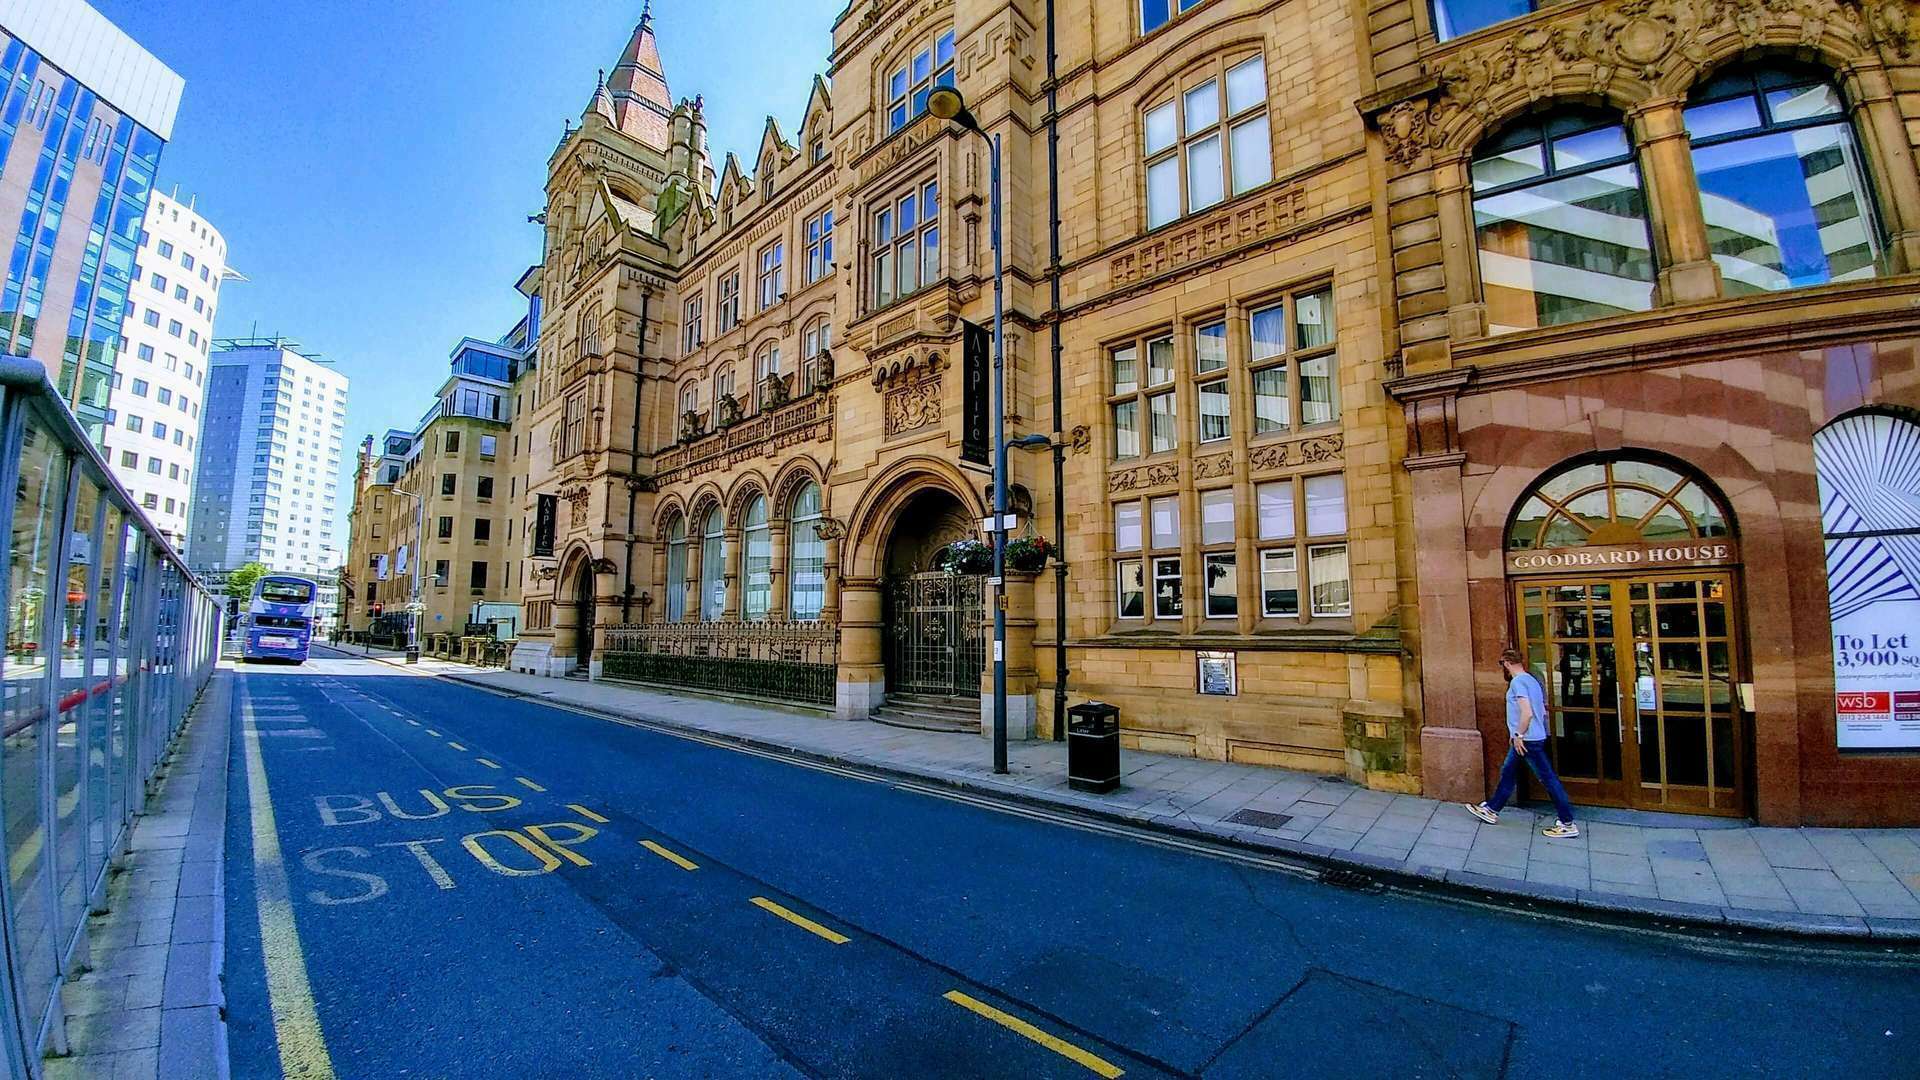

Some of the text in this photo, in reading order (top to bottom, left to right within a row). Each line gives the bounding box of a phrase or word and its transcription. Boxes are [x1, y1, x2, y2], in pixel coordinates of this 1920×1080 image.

[1514, 545, 1728, 569] GOODBARD HOUSE
[1834, 633, 1908, 650] To Let
[1837, 651, 1898, 668] 3,900
[1838, 692, 1876, 708] wsb
[313, 786, 522, 826] BUS
[301, 823, 599, 905] STOP
